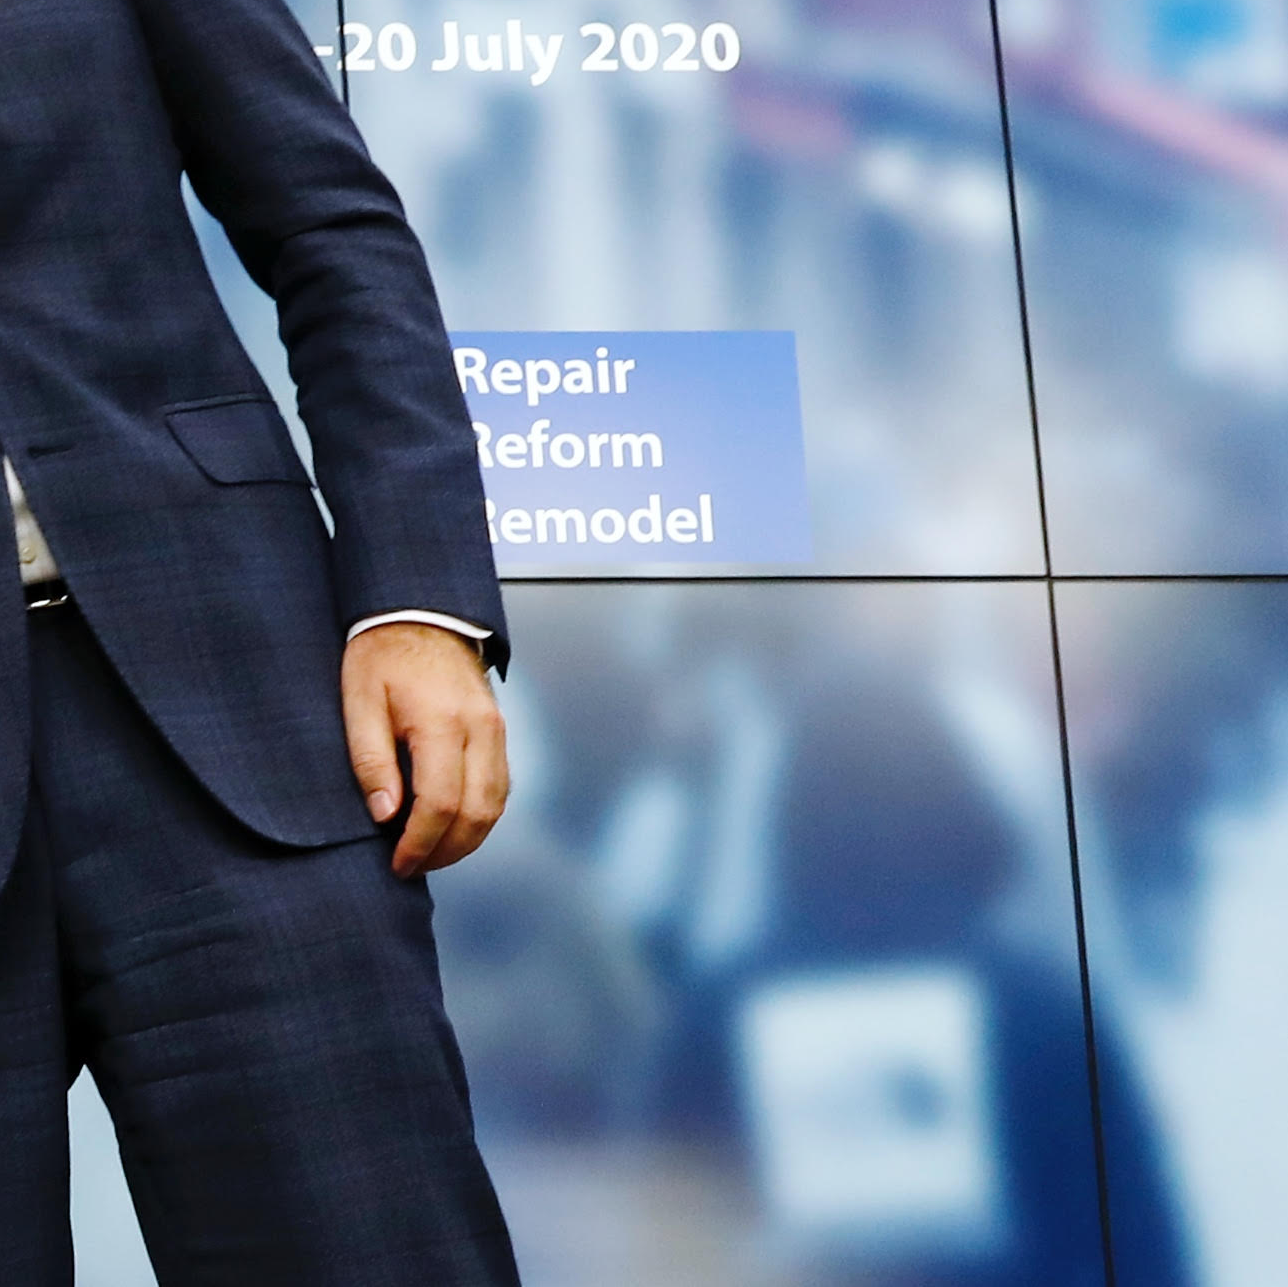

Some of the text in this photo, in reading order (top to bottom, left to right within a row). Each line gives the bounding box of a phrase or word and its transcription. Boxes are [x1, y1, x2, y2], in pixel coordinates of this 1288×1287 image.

[313, 19, 741, 87] -20 July 2020
[453, 346, 636, 407] Repair
